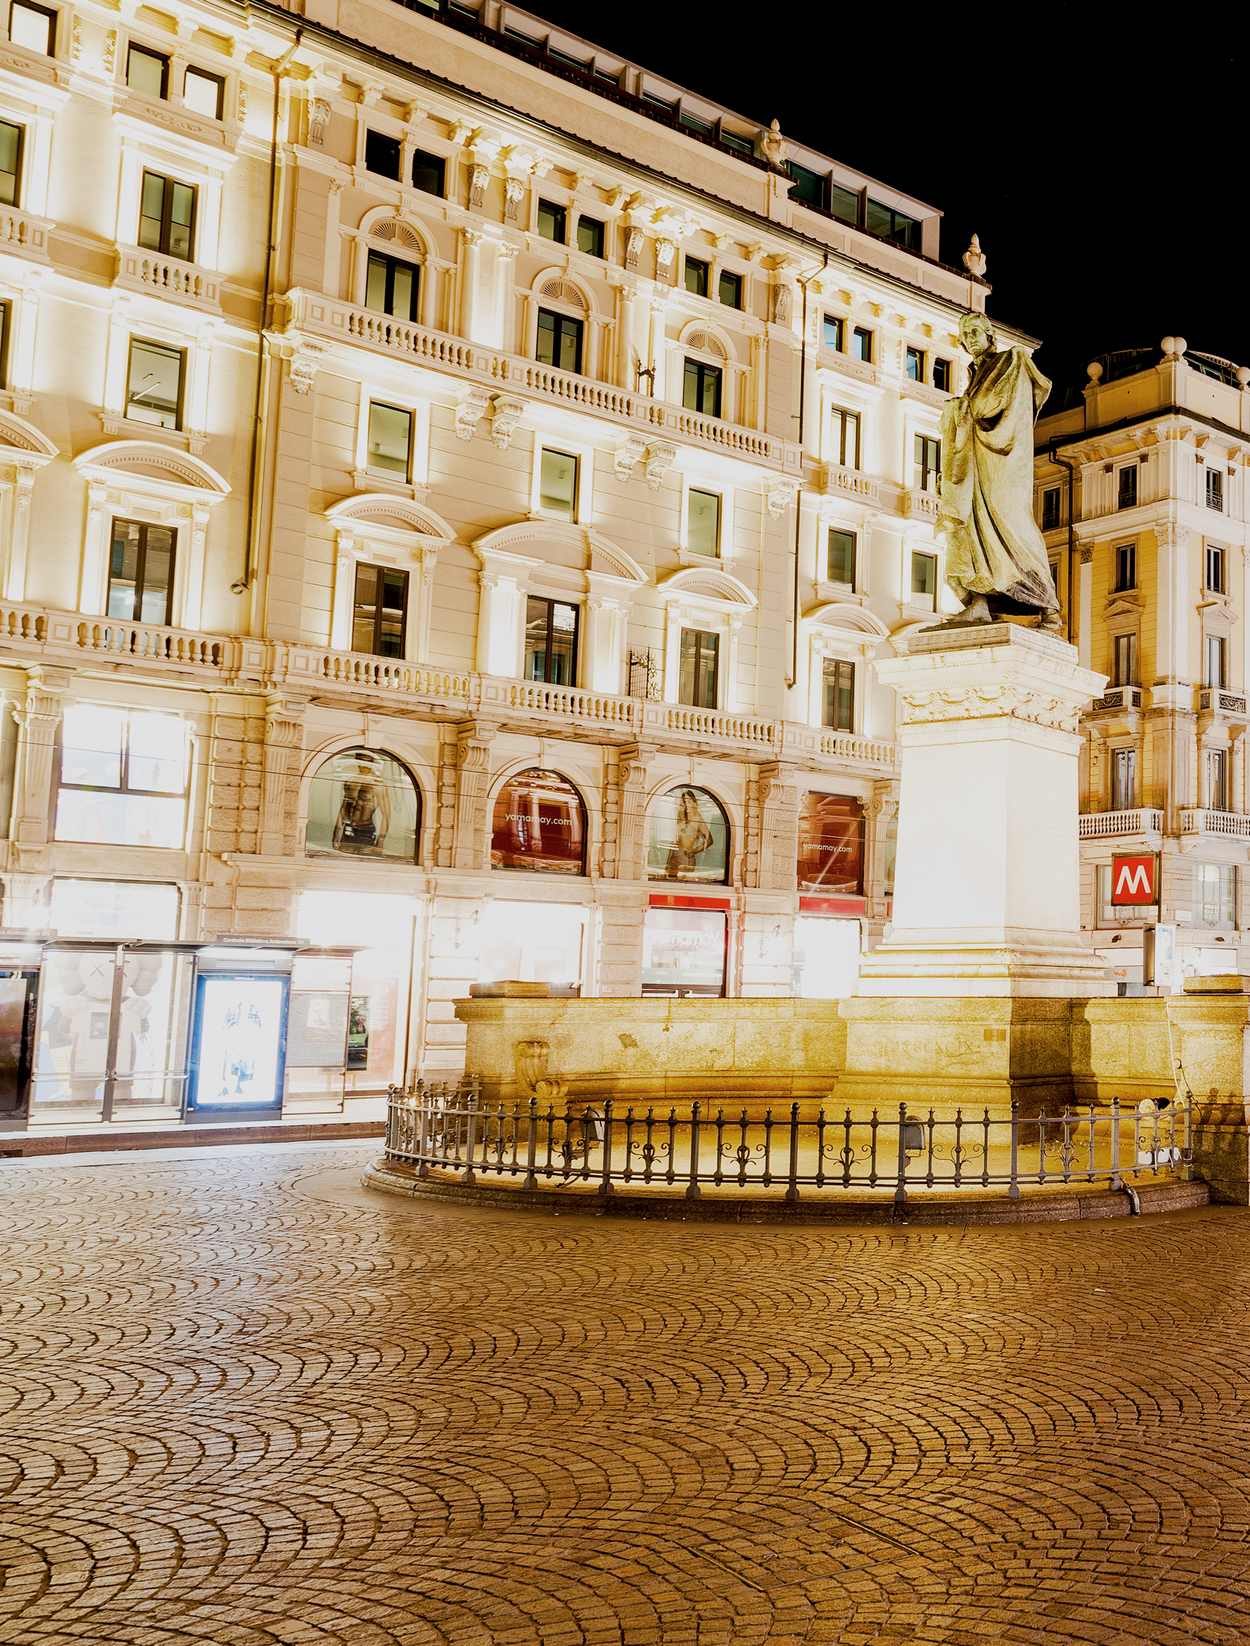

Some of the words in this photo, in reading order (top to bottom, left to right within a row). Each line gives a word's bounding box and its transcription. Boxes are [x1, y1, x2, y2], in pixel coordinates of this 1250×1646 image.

[505, 813, 572, 825] yamamay.com
[803, 843, 852, 853] yamamay.com
[1115, 865, 1151, 894] M
